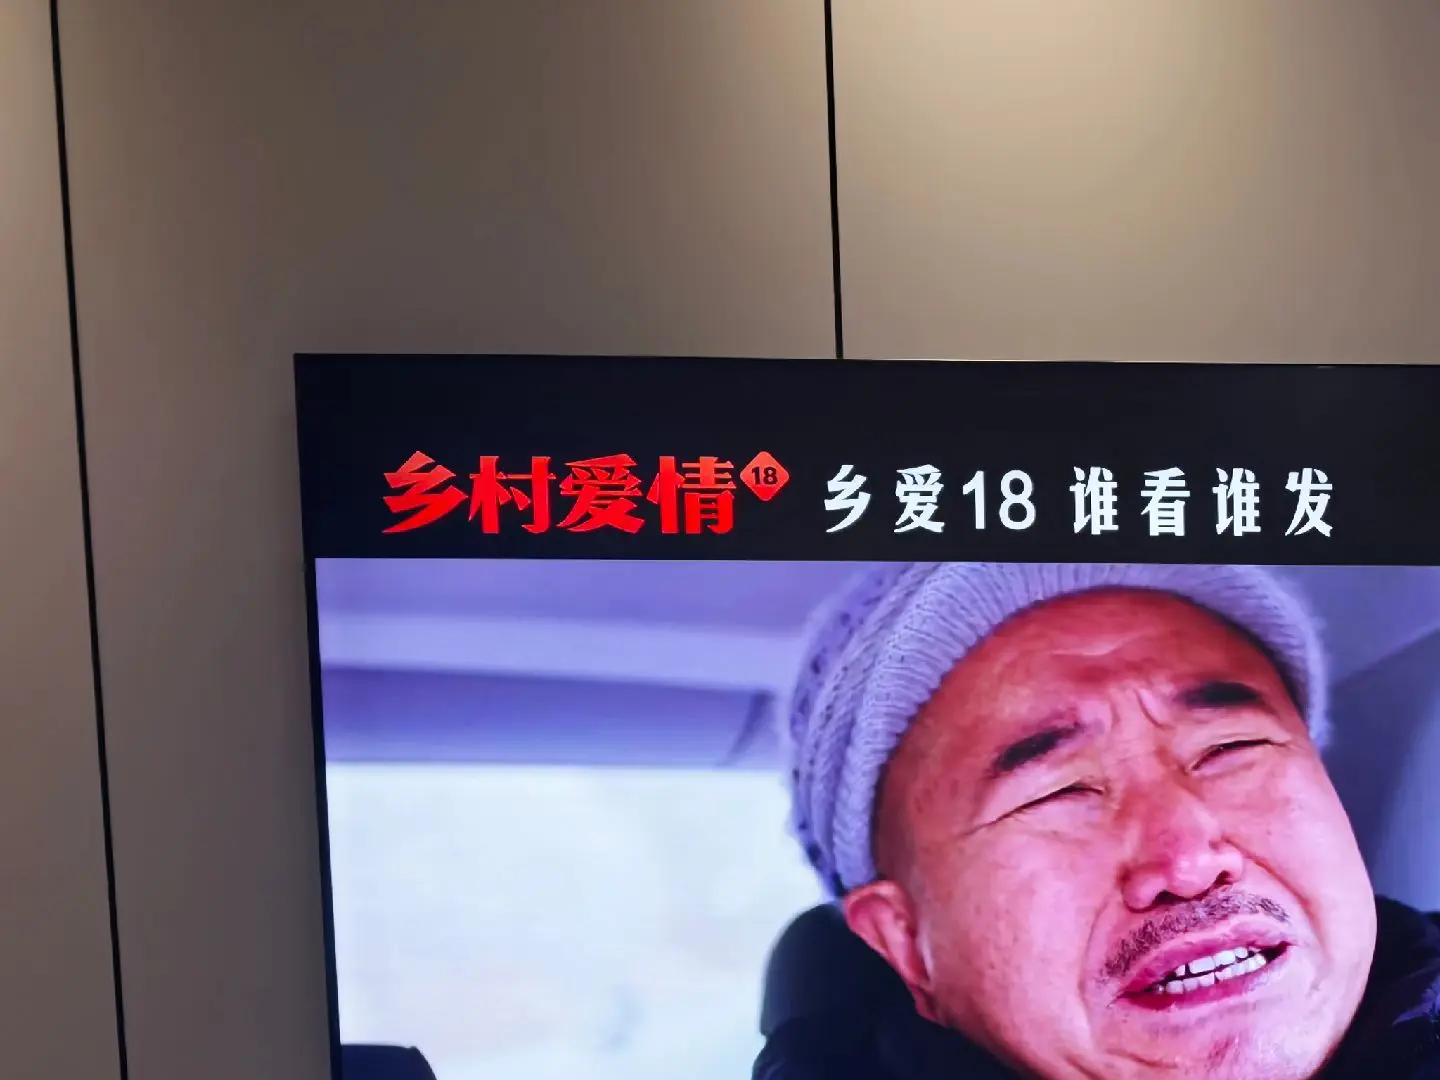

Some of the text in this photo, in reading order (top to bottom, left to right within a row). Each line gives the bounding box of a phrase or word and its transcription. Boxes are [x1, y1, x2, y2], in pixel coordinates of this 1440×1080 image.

[384, 451, 779, 535] 乡村爱情 18
